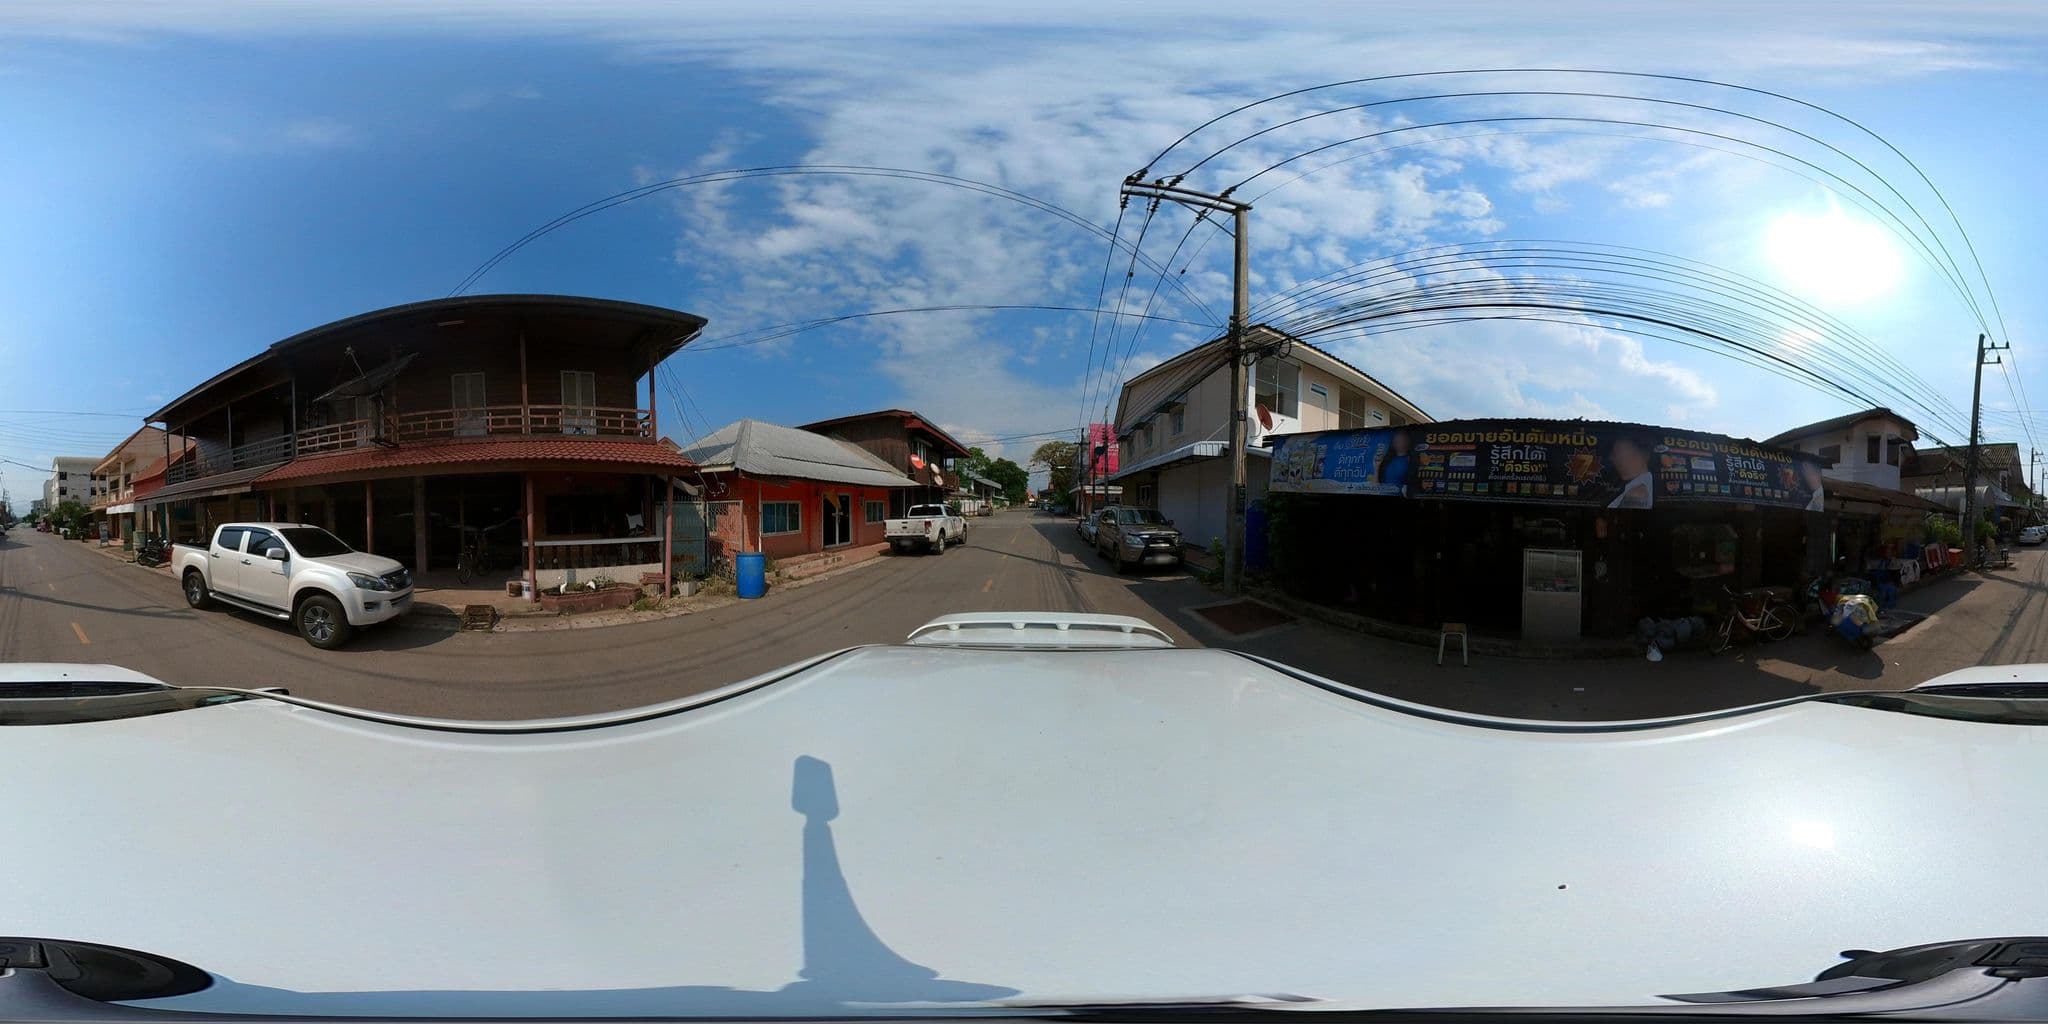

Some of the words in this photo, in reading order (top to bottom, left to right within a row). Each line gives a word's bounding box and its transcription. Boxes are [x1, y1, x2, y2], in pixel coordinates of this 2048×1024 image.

[1426, 427, 1598, 446] ยอดขายอันดับหนึ่ง
[1490, 444, 1547, 464] รู้สึกได้
